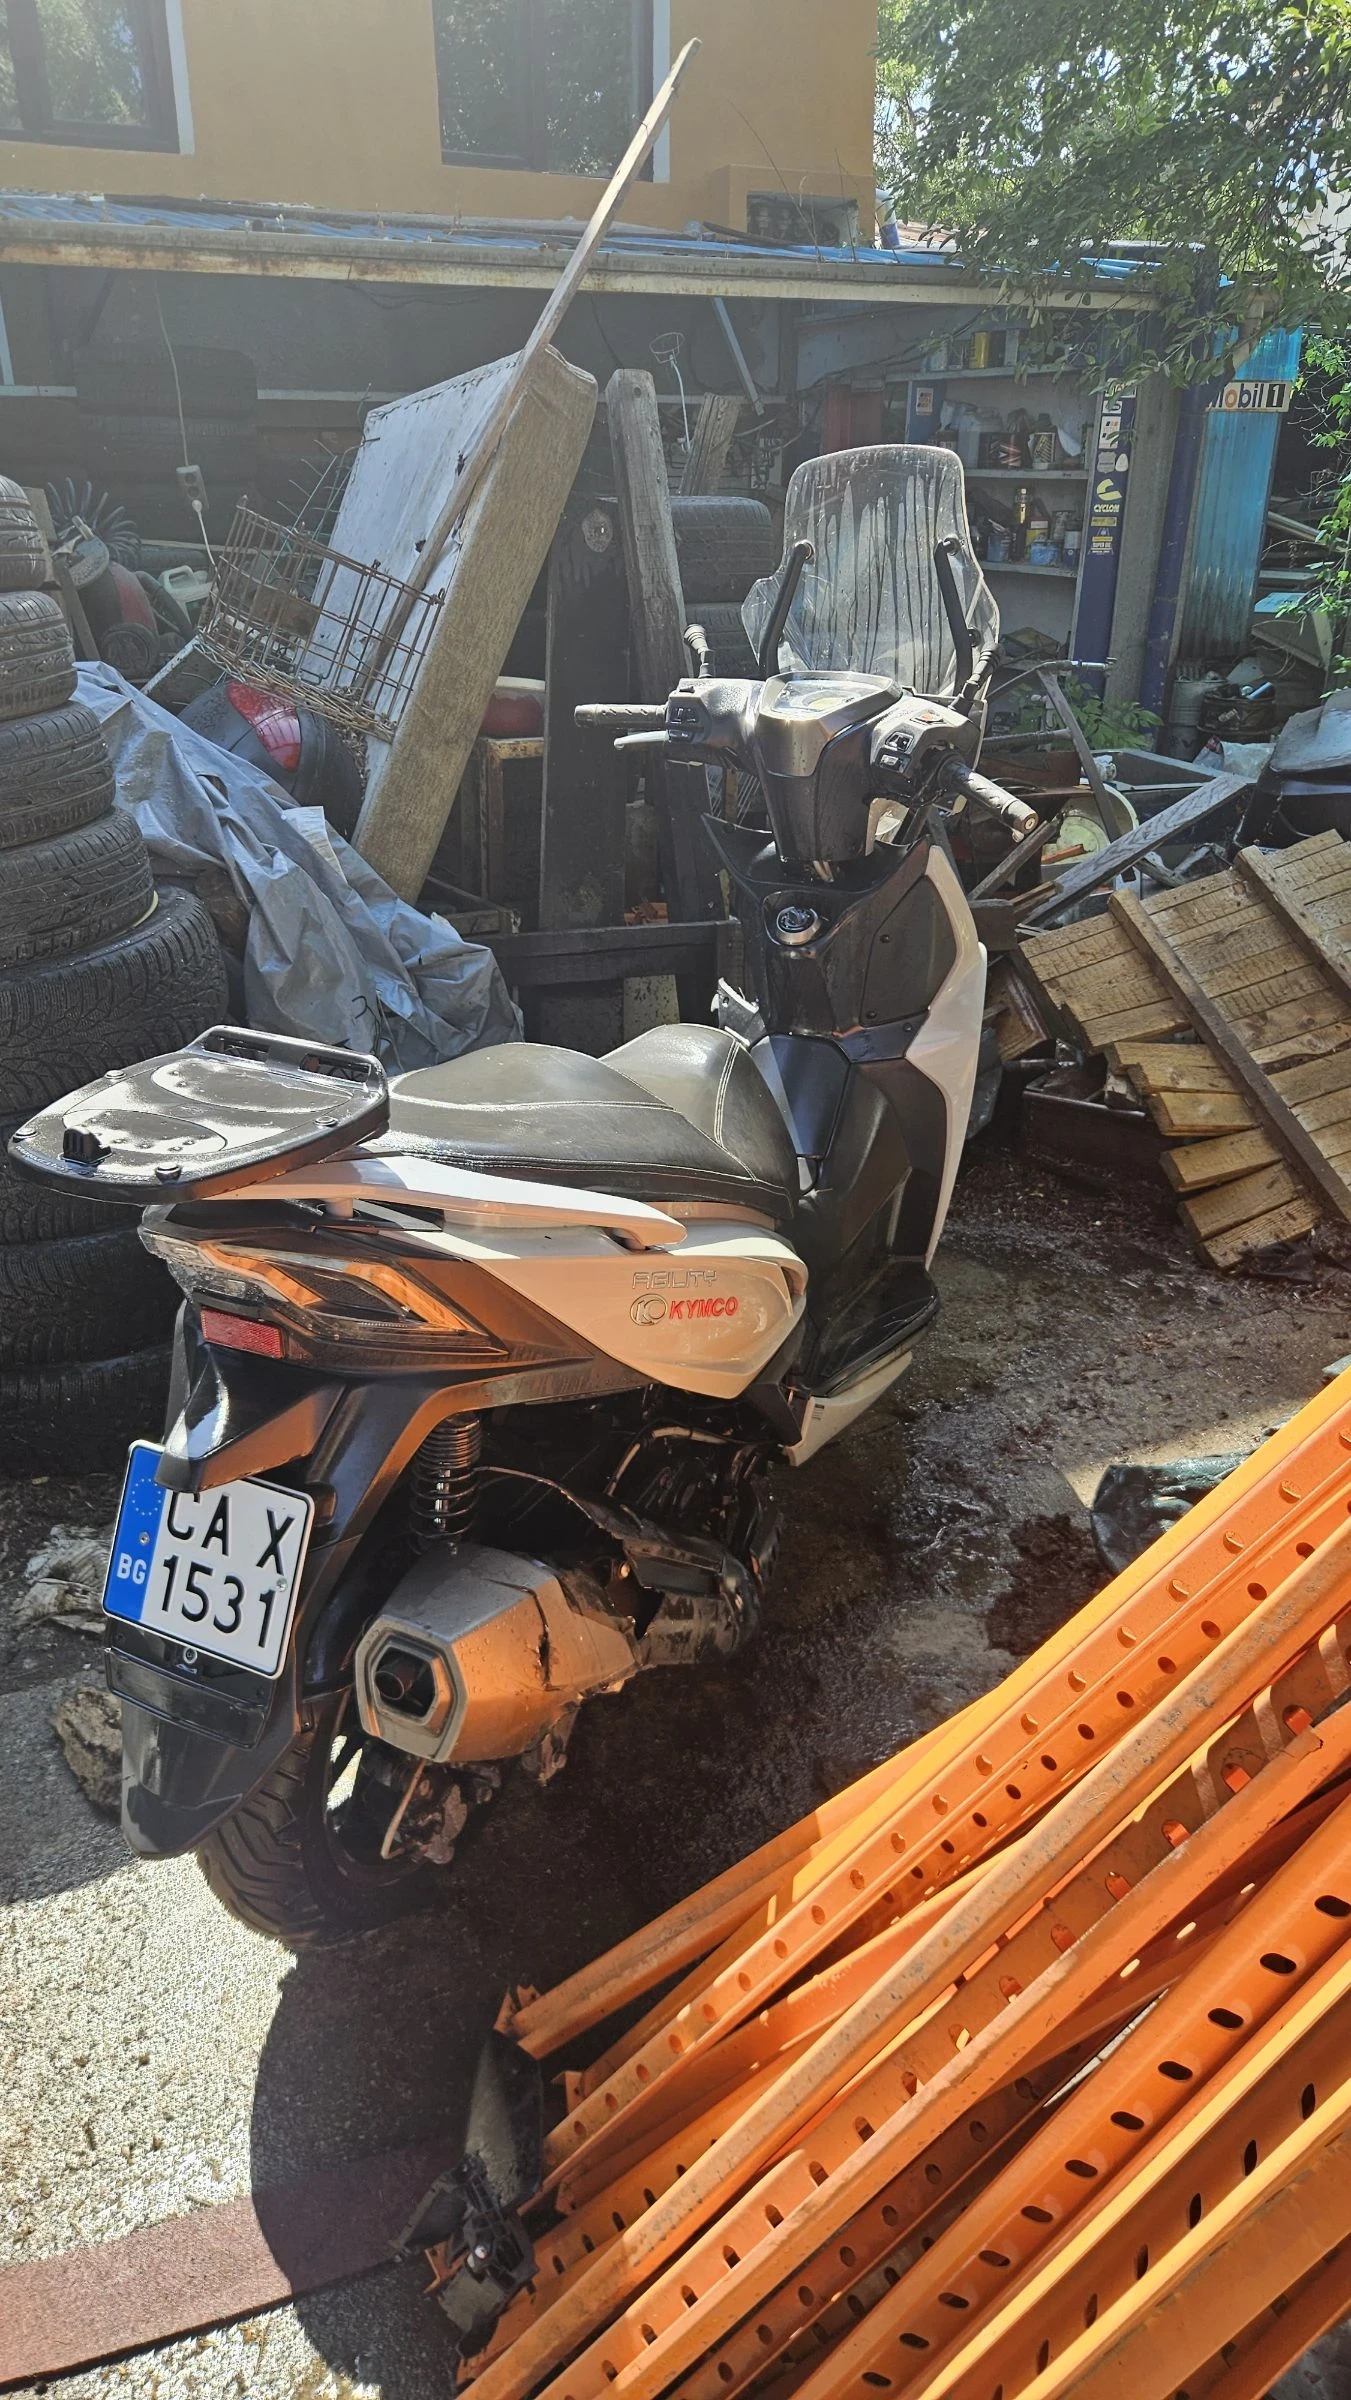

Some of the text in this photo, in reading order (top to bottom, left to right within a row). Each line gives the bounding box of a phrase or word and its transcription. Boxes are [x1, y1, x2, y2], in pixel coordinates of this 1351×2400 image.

[1093, 504, 1120, 513] CYCLON
[632, 1270, 718, 1290] AGILITY
[669, 1296, 739, 1320] KYMCO
[166, 1491, 295, 1576] CA X
[116, 1553, 147, 1585] BG
[161, 1554, 278, 1649] 1531
